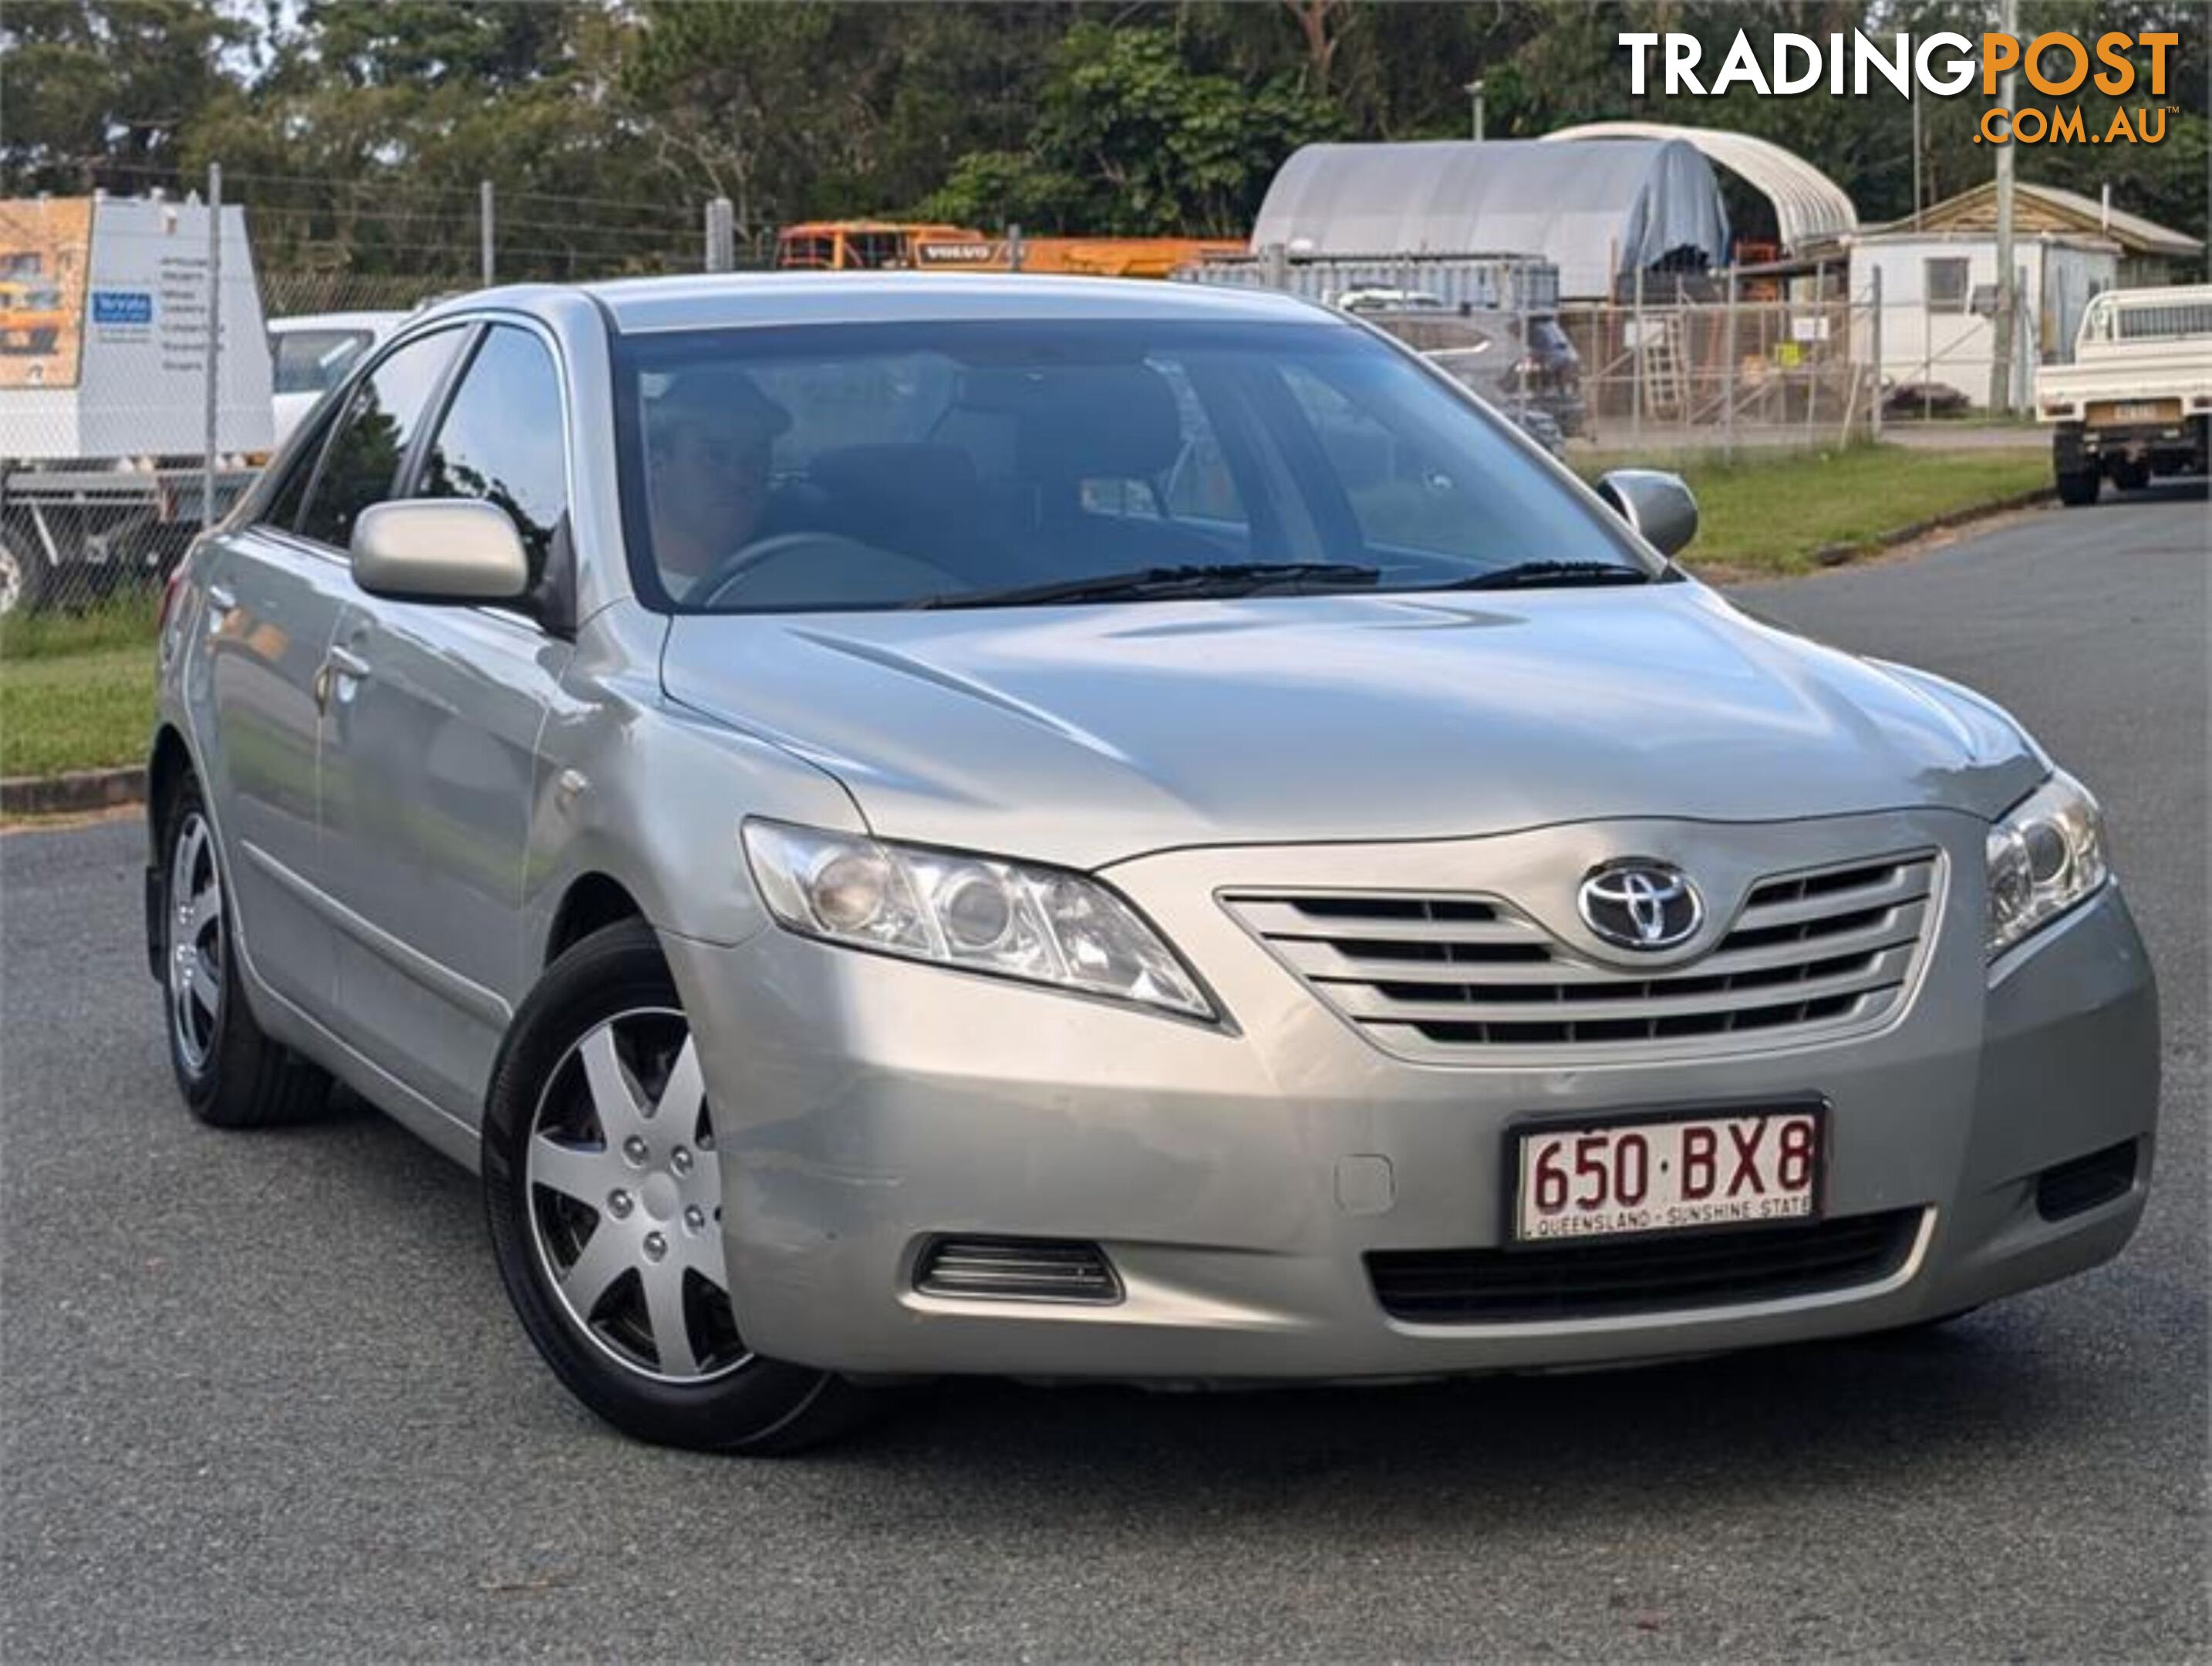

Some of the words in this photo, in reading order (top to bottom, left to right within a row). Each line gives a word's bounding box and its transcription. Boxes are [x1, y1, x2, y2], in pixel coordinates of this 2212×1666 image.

[927, 245, 989, 258] VOLVO
[1538, 1209, 1650, 1235] QUEENSLAND
[1667, 1200, 1753, 1224] SUNSHINE
[1761, 1196, 1811, 1217] STATE
